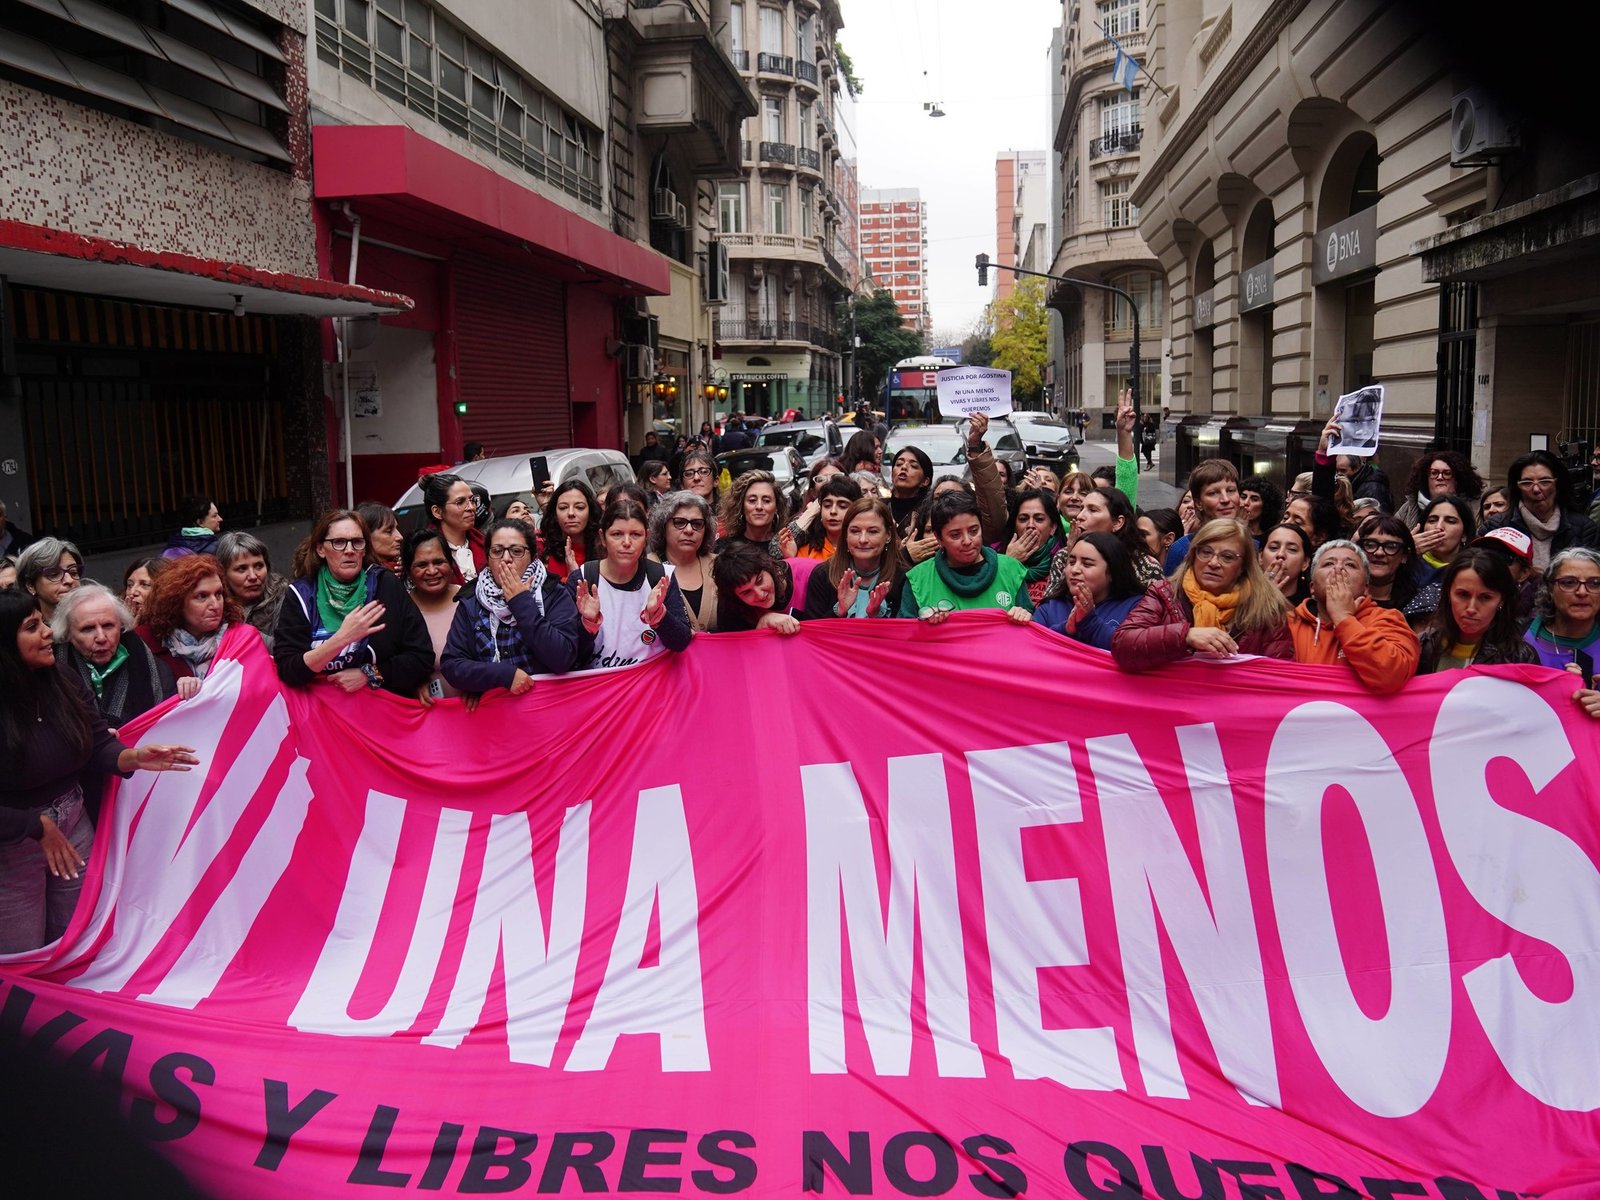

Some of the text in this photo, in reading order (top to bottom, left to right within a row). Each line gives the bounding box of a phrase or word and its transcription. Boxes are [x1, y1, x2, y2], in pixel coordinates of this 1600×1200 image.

[1339, 229, 1361, 262] BNA
[1254, 273, 1268, 297] BNA
[996, 592, 1012, 606] ATE
[50, 658, 1600, 1118] NI UNA MENOS
[253, 1078, 339, 1172] Y
[346, 1104, 758, 1195] LIBRES
[802, 1130, 1028, 1199] NOS
